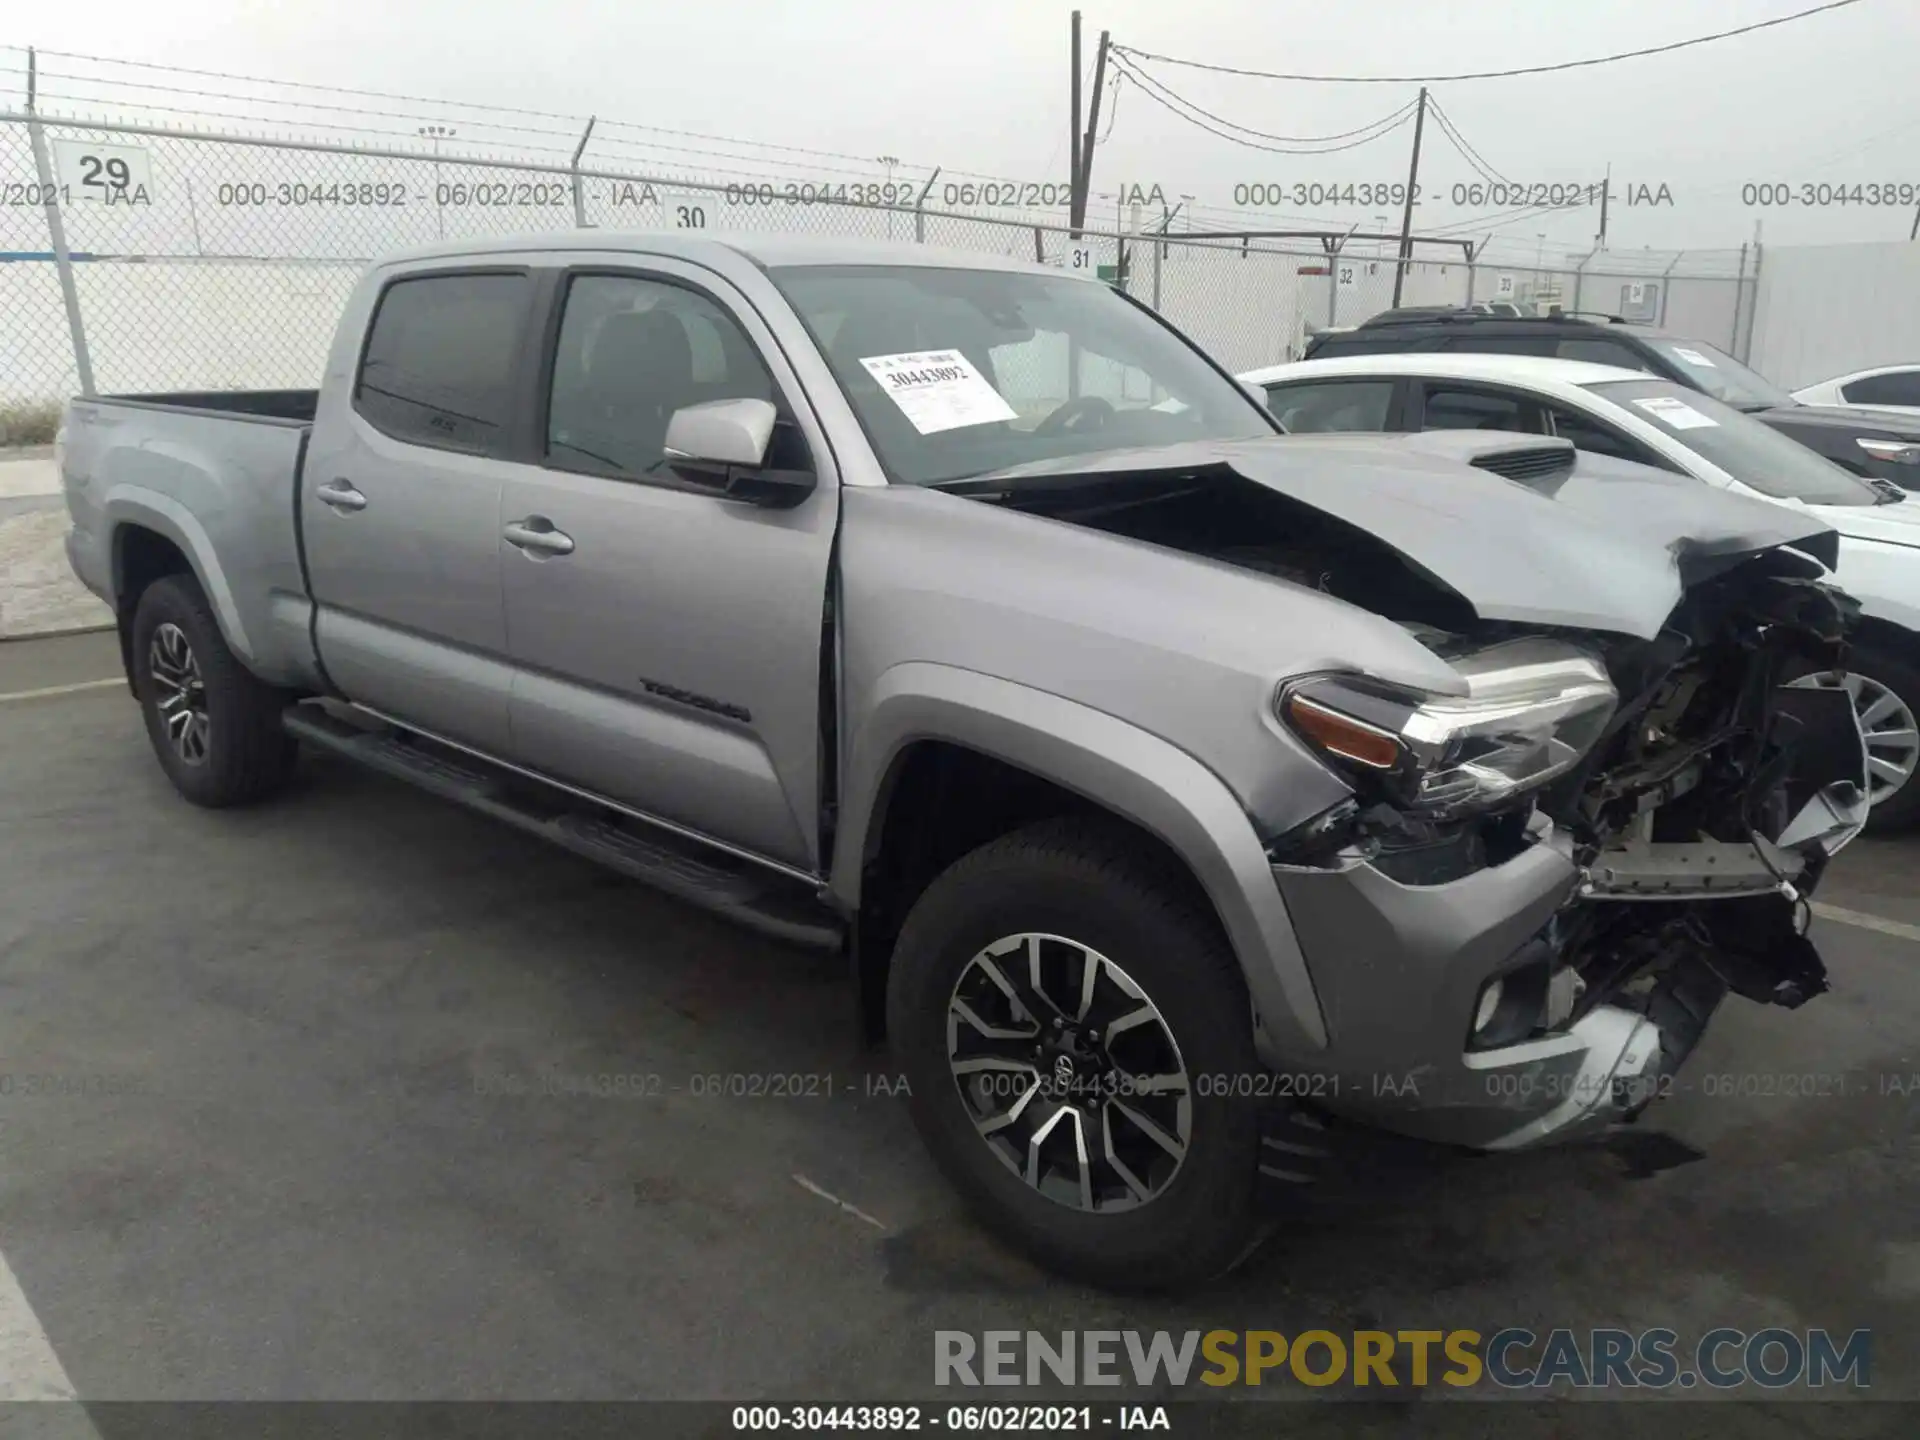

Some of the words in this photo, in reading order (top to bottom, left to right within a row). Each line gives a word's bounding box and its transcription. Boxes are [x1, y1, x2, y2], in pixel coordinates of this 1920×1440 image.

[80, 156, 130, 188] 29
[677, 206, 705, 228] 30
[1073, 249, 1089, 268] 31
[1340, 268, 1353, 284] 32
[886, 365, 968, 388] 30443892
